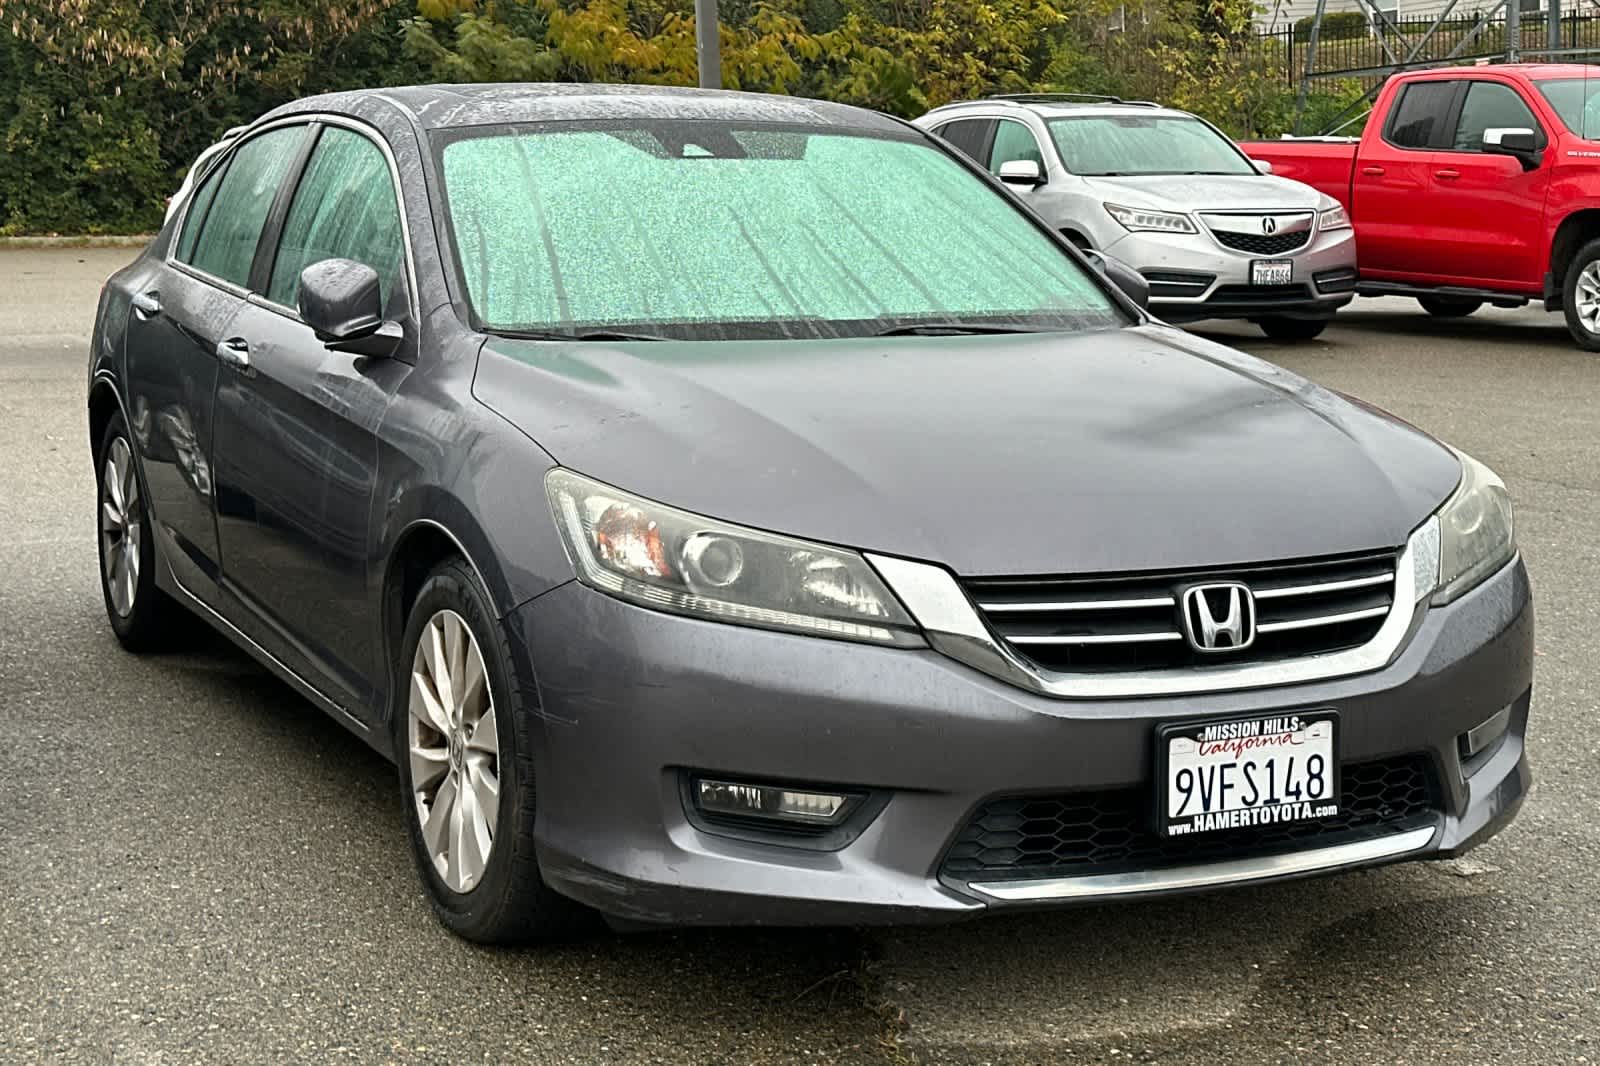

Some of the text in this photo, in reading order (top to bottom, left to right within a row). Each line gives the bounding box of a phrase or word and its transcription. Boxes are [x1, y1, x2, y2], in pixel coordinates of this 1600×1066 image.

[1204, 717, 1299, 741] MISSION HILLS
[1199, 733, 1305, 759] California
[1175, 754, 1325, 817] 9VFS148
[1168, 802, 1338, 836] www.HAMERTOYOTA.com
